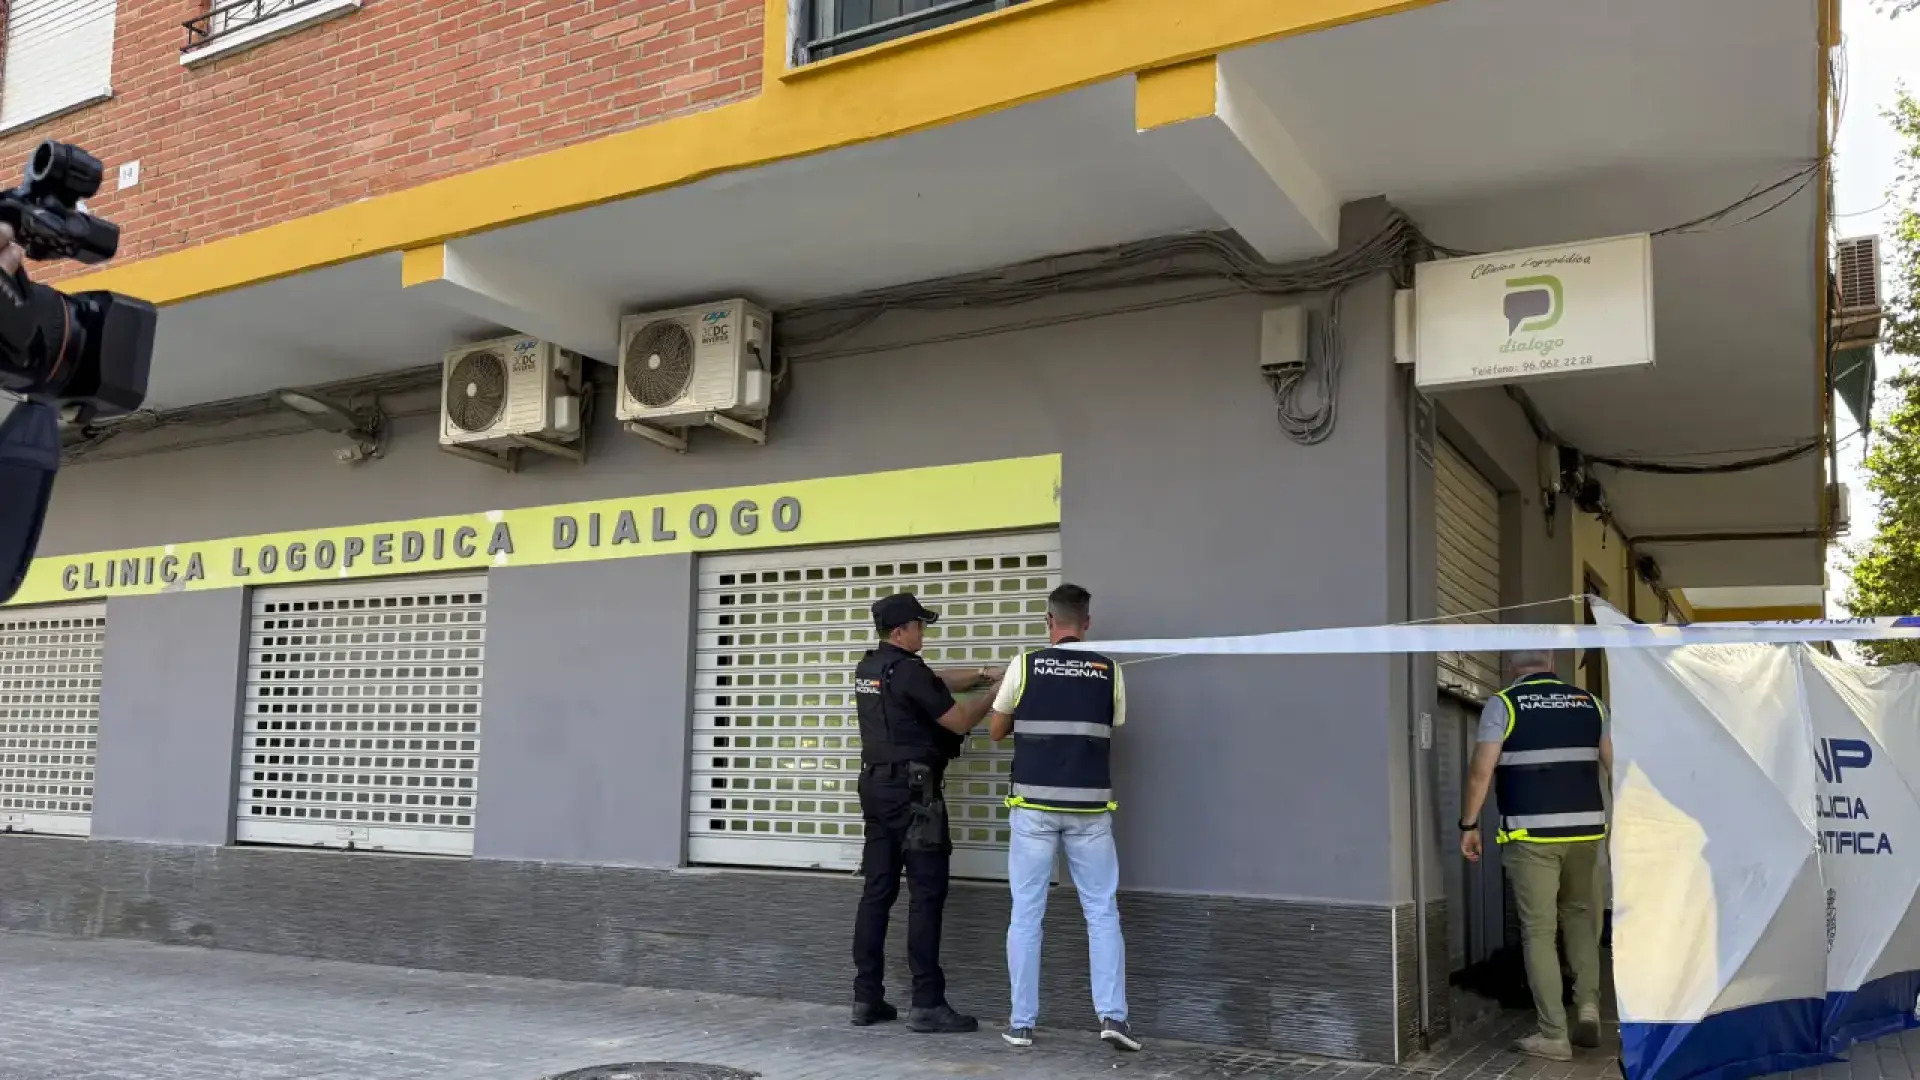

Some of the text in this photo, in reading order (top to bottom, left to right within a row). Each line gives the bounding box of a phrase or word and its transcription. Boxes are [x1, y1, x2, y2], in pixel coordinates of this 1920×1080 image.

[62, 496, 801, 591] CLINICA LOGOPEDICA DIALOGO
[1034, 658, 1093, 669] POLICIA
[1034, 667, 1108, 680] NACIONAL
[1517, 693, 1576, 702] POLICIA
[1520, 700, 1594, 711] NACIONAL
